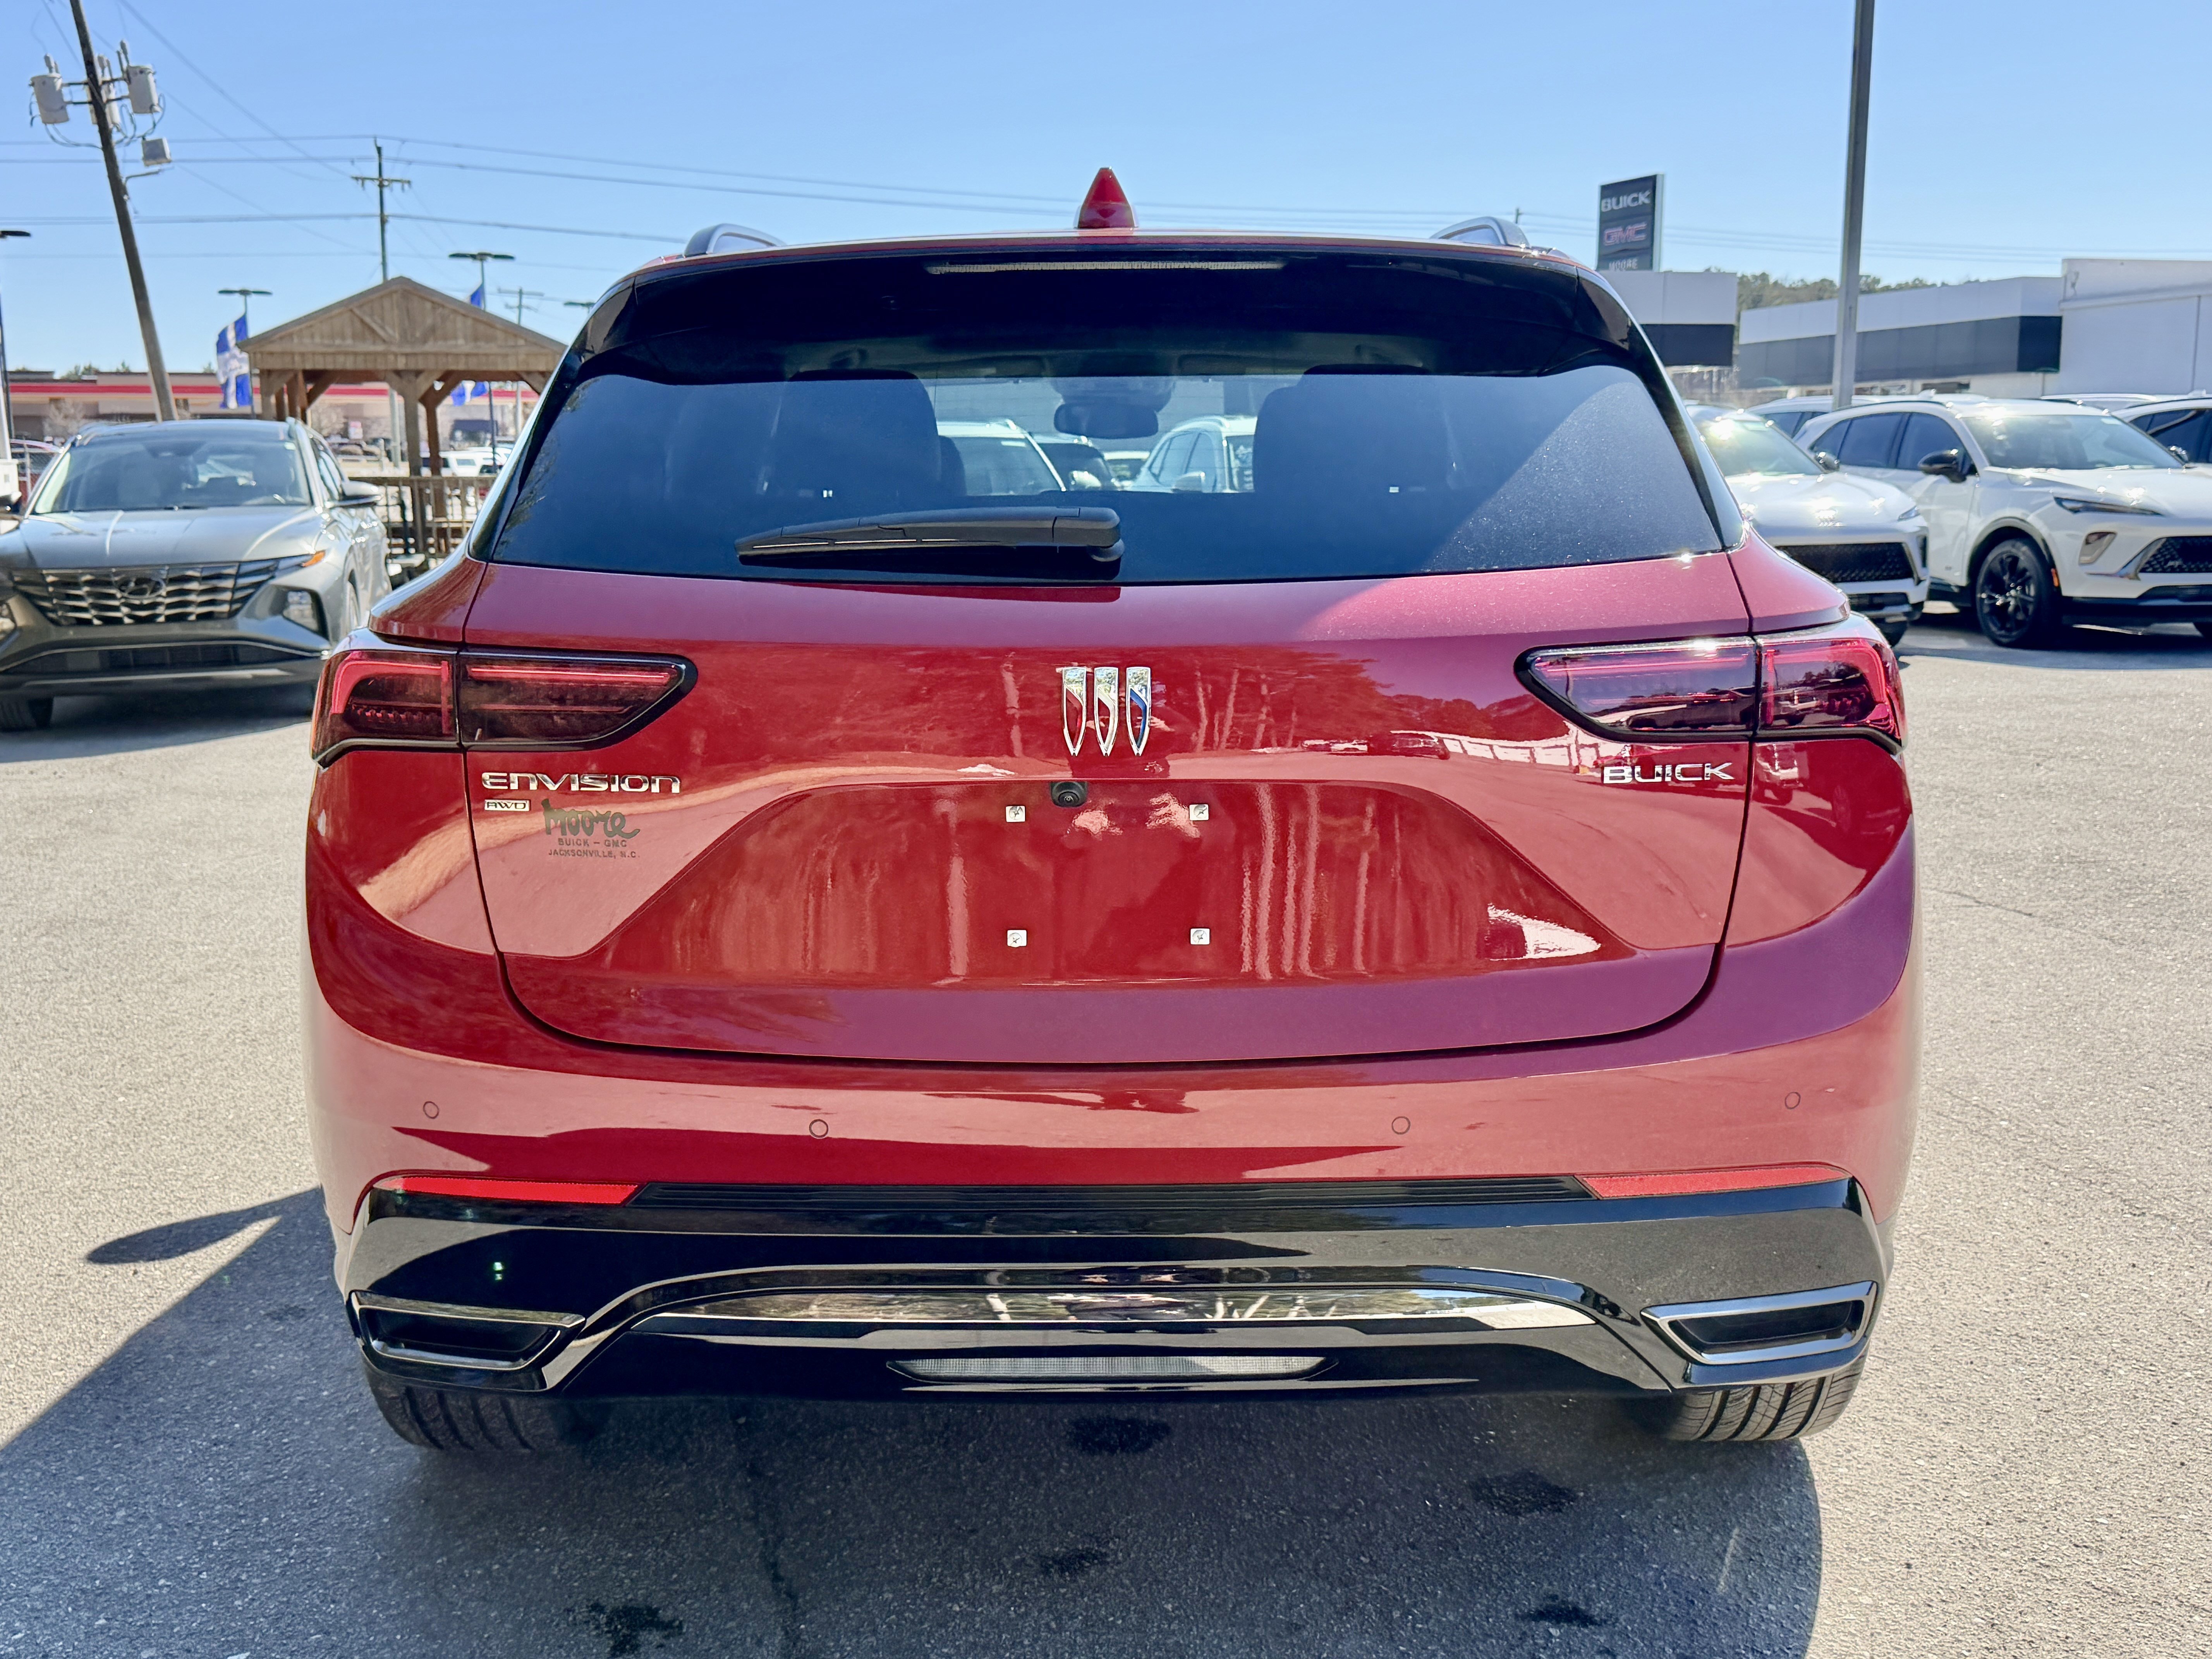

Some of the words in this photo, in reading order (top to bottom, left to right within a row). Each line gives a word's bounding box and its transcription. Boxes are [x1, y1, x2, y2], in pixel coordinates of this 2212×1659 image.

[1601, 190, 1651, 212] BUICK
[1603, 221, 1647, 246] GMC
[481, 772, 680, 793] ENVISION
[1603, 762, 1735, 784] BUICK
[558, 838, 590, 847] BUICK
[604, 839, 627, 847] GMC
[548, 849, 616, 859] JACKSONVILLE,
